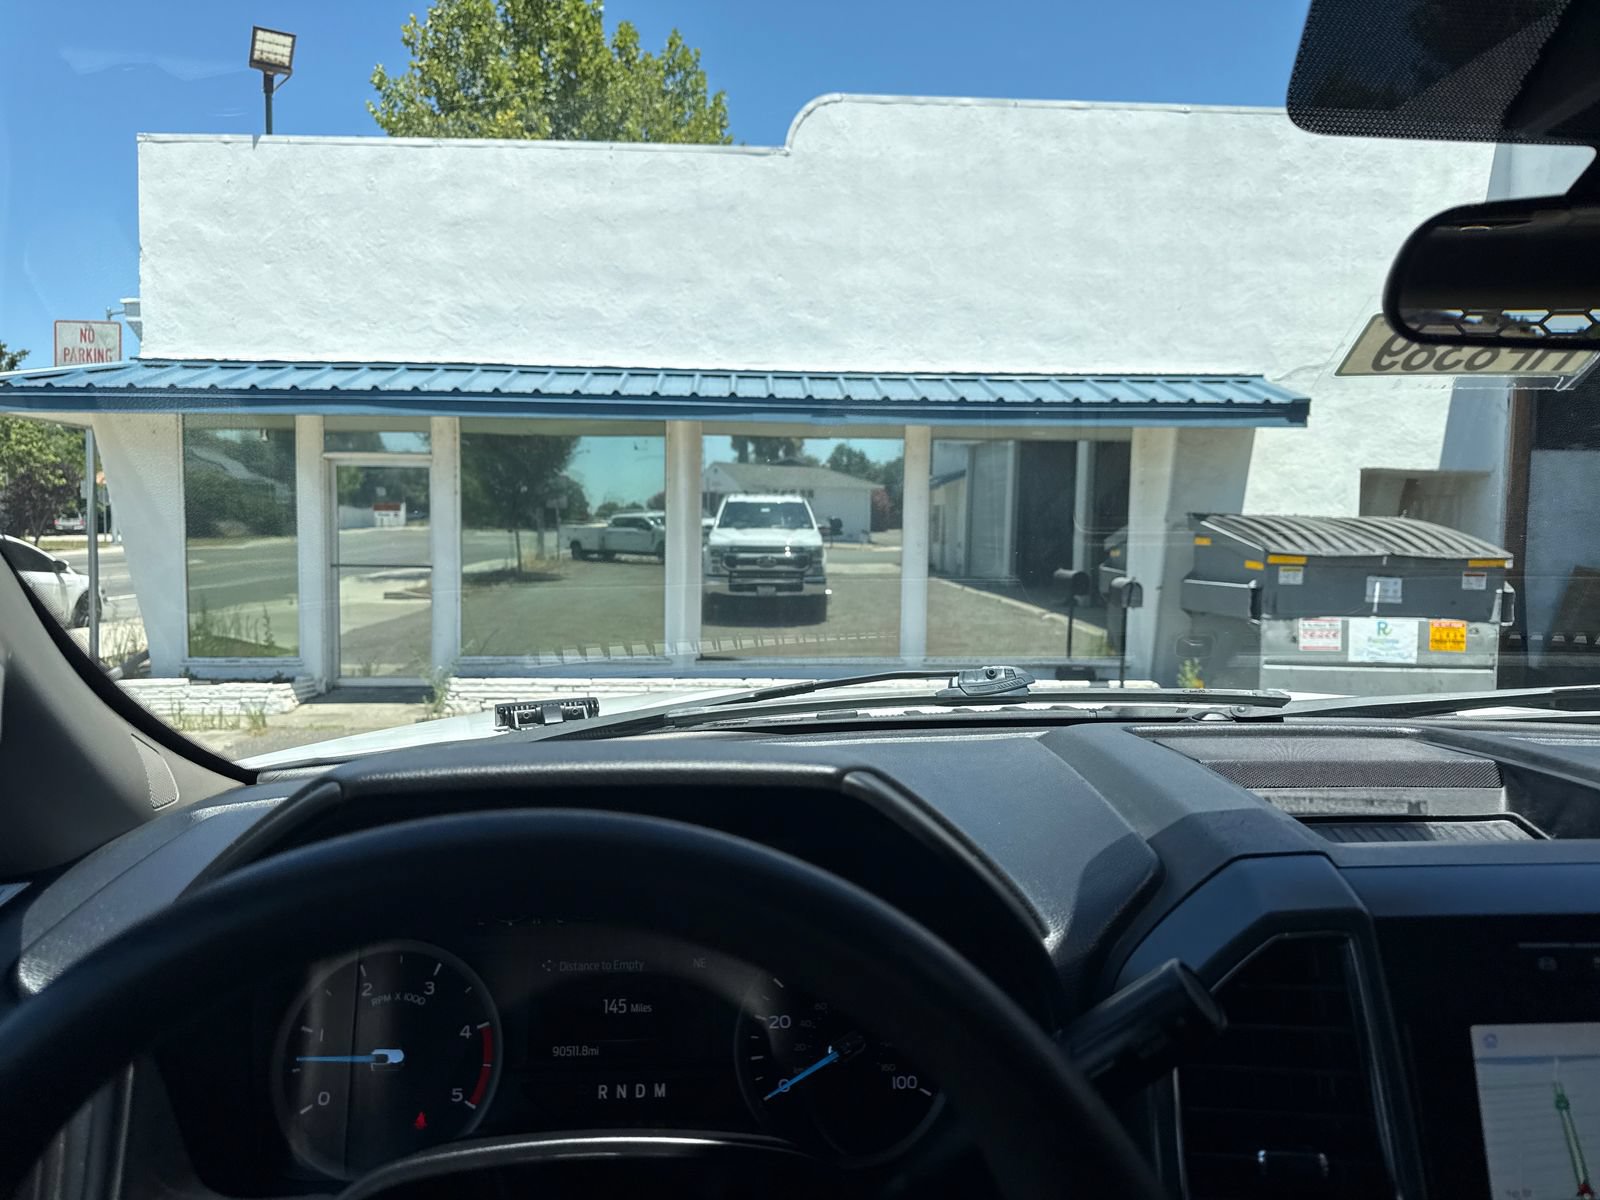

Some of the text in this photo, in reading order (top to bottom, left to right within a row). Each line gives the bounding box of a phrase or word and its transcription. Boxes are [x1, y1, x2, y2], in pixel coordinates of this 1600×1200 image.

[80, 327, 95, 343] NO
[63, 347, 112, 363] PARKING
[559, 960, 645, 973] Distance to Empty
[693, 958, 707, 969] NE
[361, 983, 373, 997] 2
[424, 981, 436, 995] 3
[371, 992, 427, 1007] RPM X 1000
[602, 998, 653, 1014] 145 Miles
[768, 1014, 792, 1029] 20
[459, 1024, 473, 1040] 4
[551, 1045, 600, 1057] 90511.8mi
[891, 1075, 918, 1090] 100
[318, 1091, 331, 1106] 0
[451, 1087, 464, 1102] 5
[597, 1083, 666, 1099] R N D M
